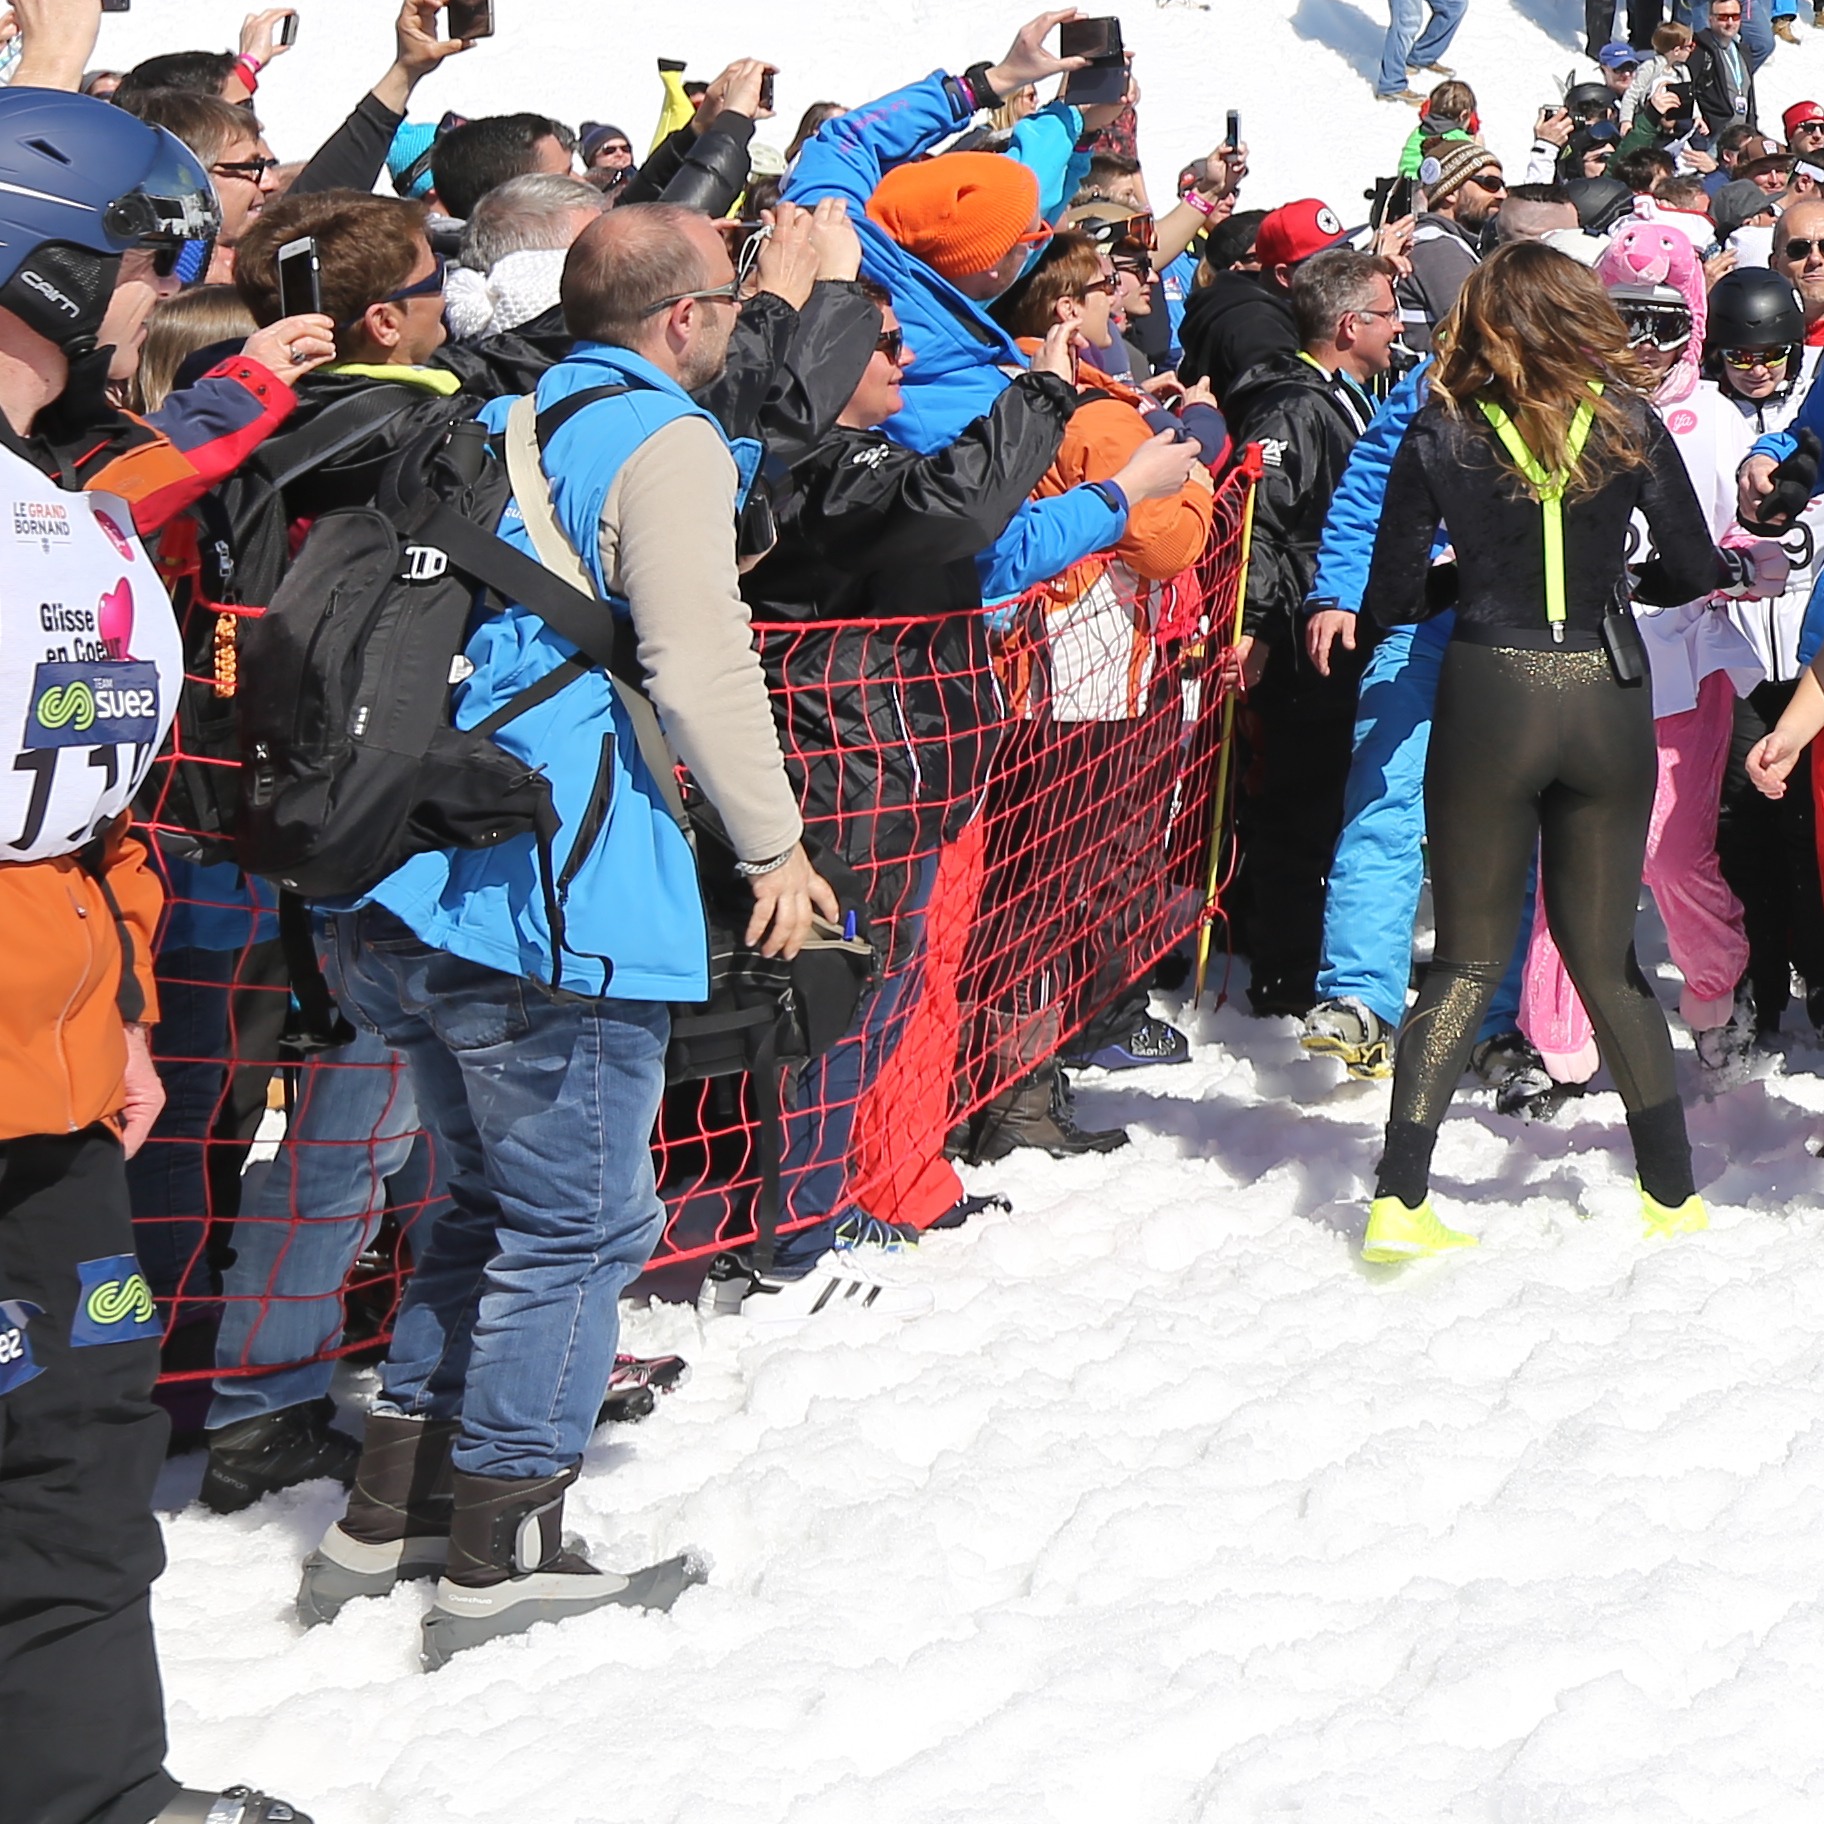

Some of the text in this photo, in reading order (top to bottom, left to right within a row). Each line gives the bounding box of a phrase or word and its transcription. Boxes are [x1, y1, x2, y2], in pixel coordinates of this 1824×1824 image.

[13, 502, 67, 520] LE GRAND
[14, 518, 71, 537] BORNAND
[40, 602, 95, 634] Glisse
[74, 636, 122, 661] Coeur
[93, 678, 114, 689] TEAM
[95, 690, 156, 719] suez
